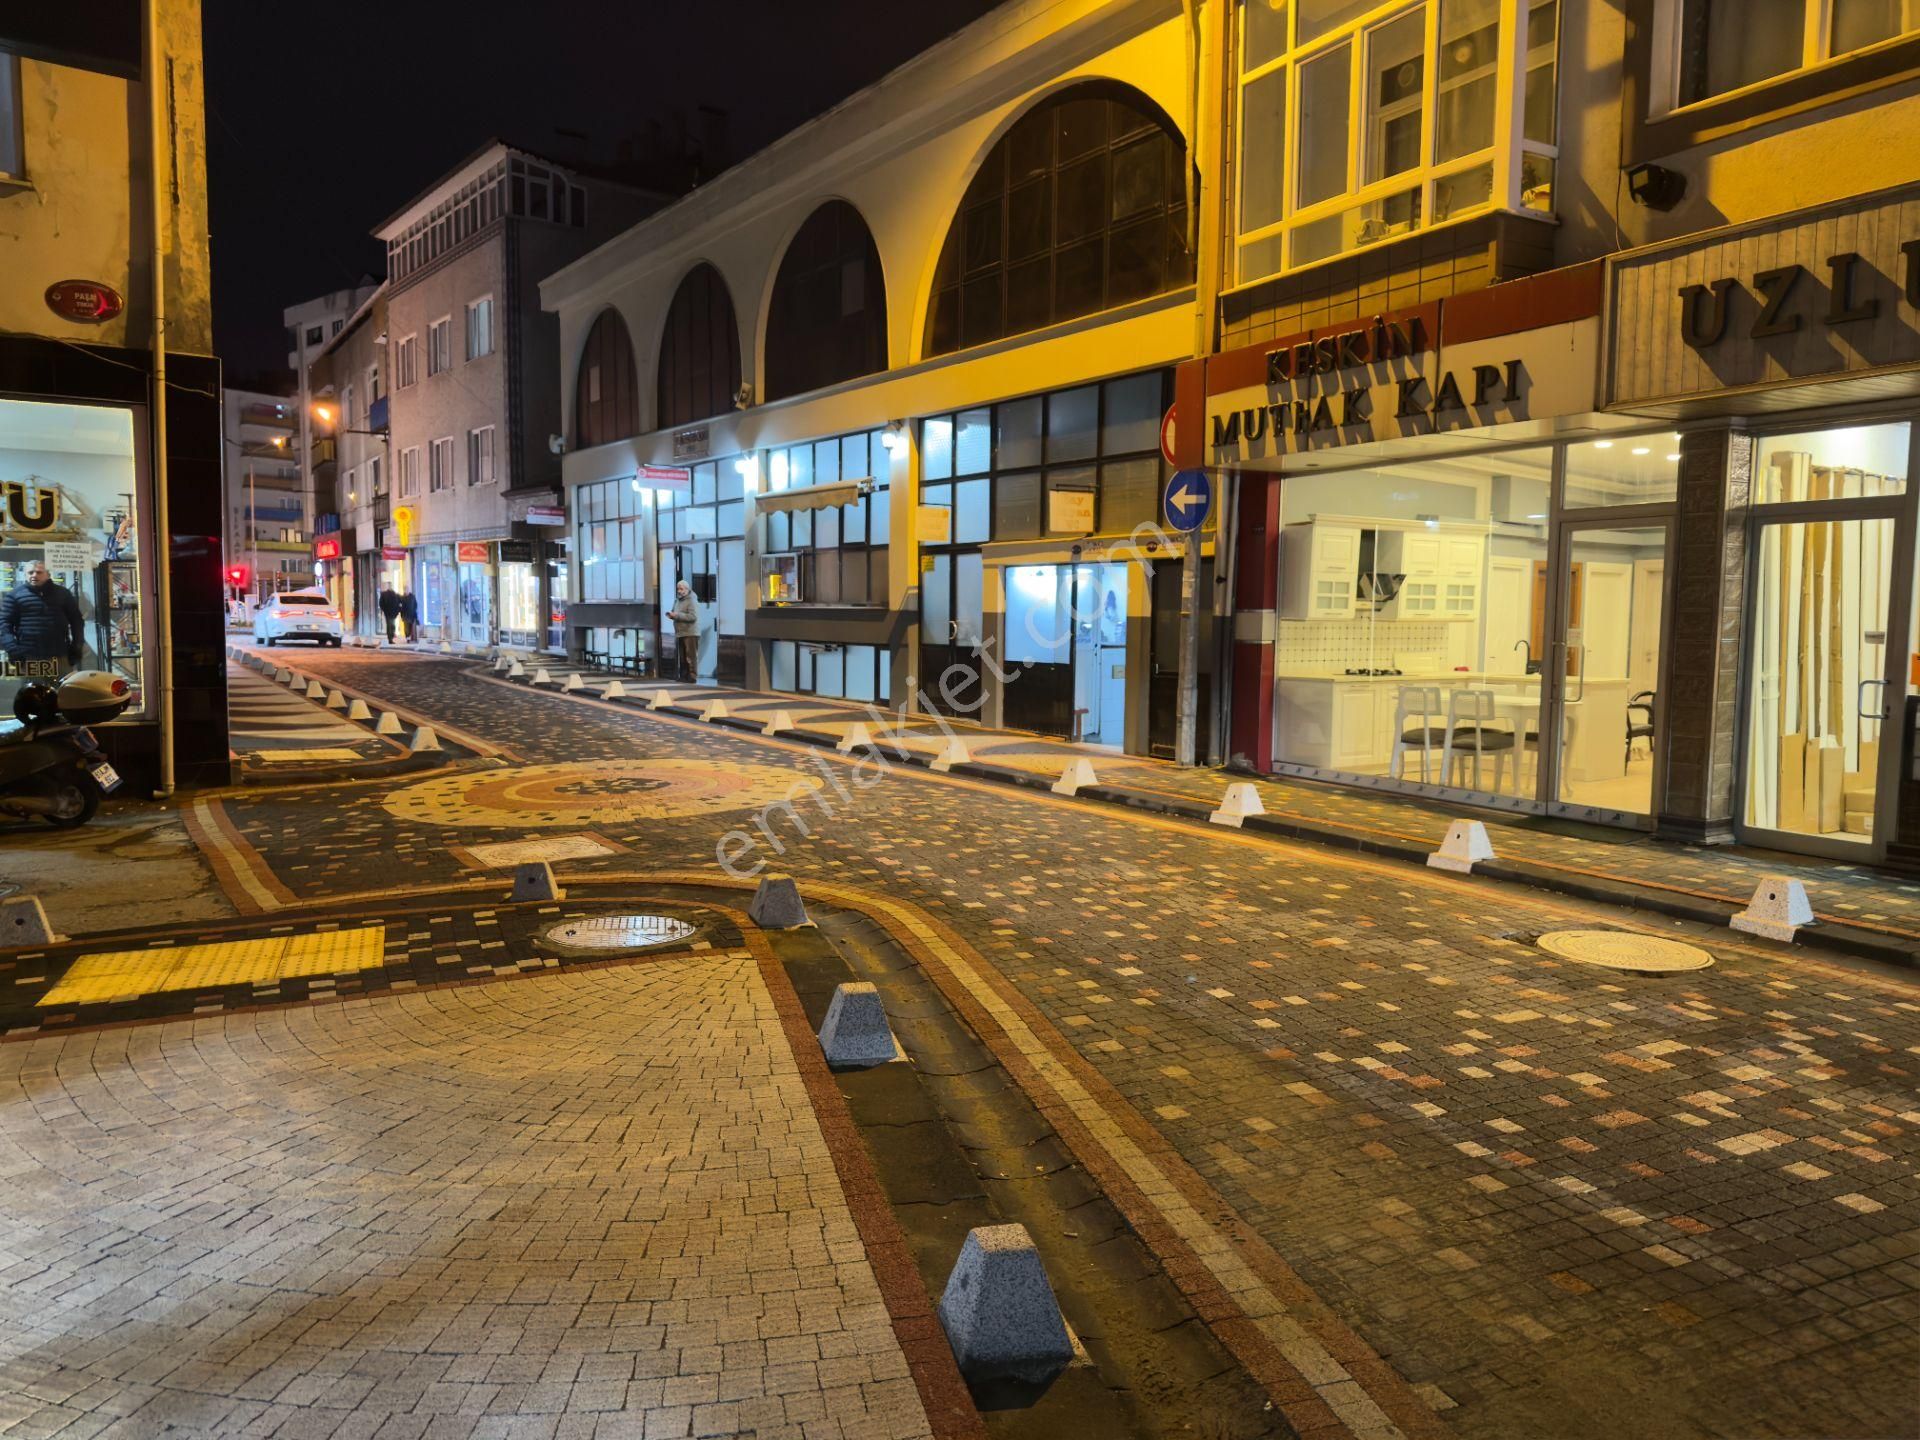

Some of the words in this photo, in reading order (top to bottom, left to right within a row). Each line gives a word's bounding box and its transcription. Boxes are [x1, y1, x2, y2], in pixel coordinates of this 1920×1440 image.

[1265, 315, 1422, 385] KESKİN
[1212, 387, 1370, 447] MUTFAK
[1394, 359, 1523, 418] KAPI
[0, 481, 60, 532] U
[0, 657, 59, 677] LLERİ
